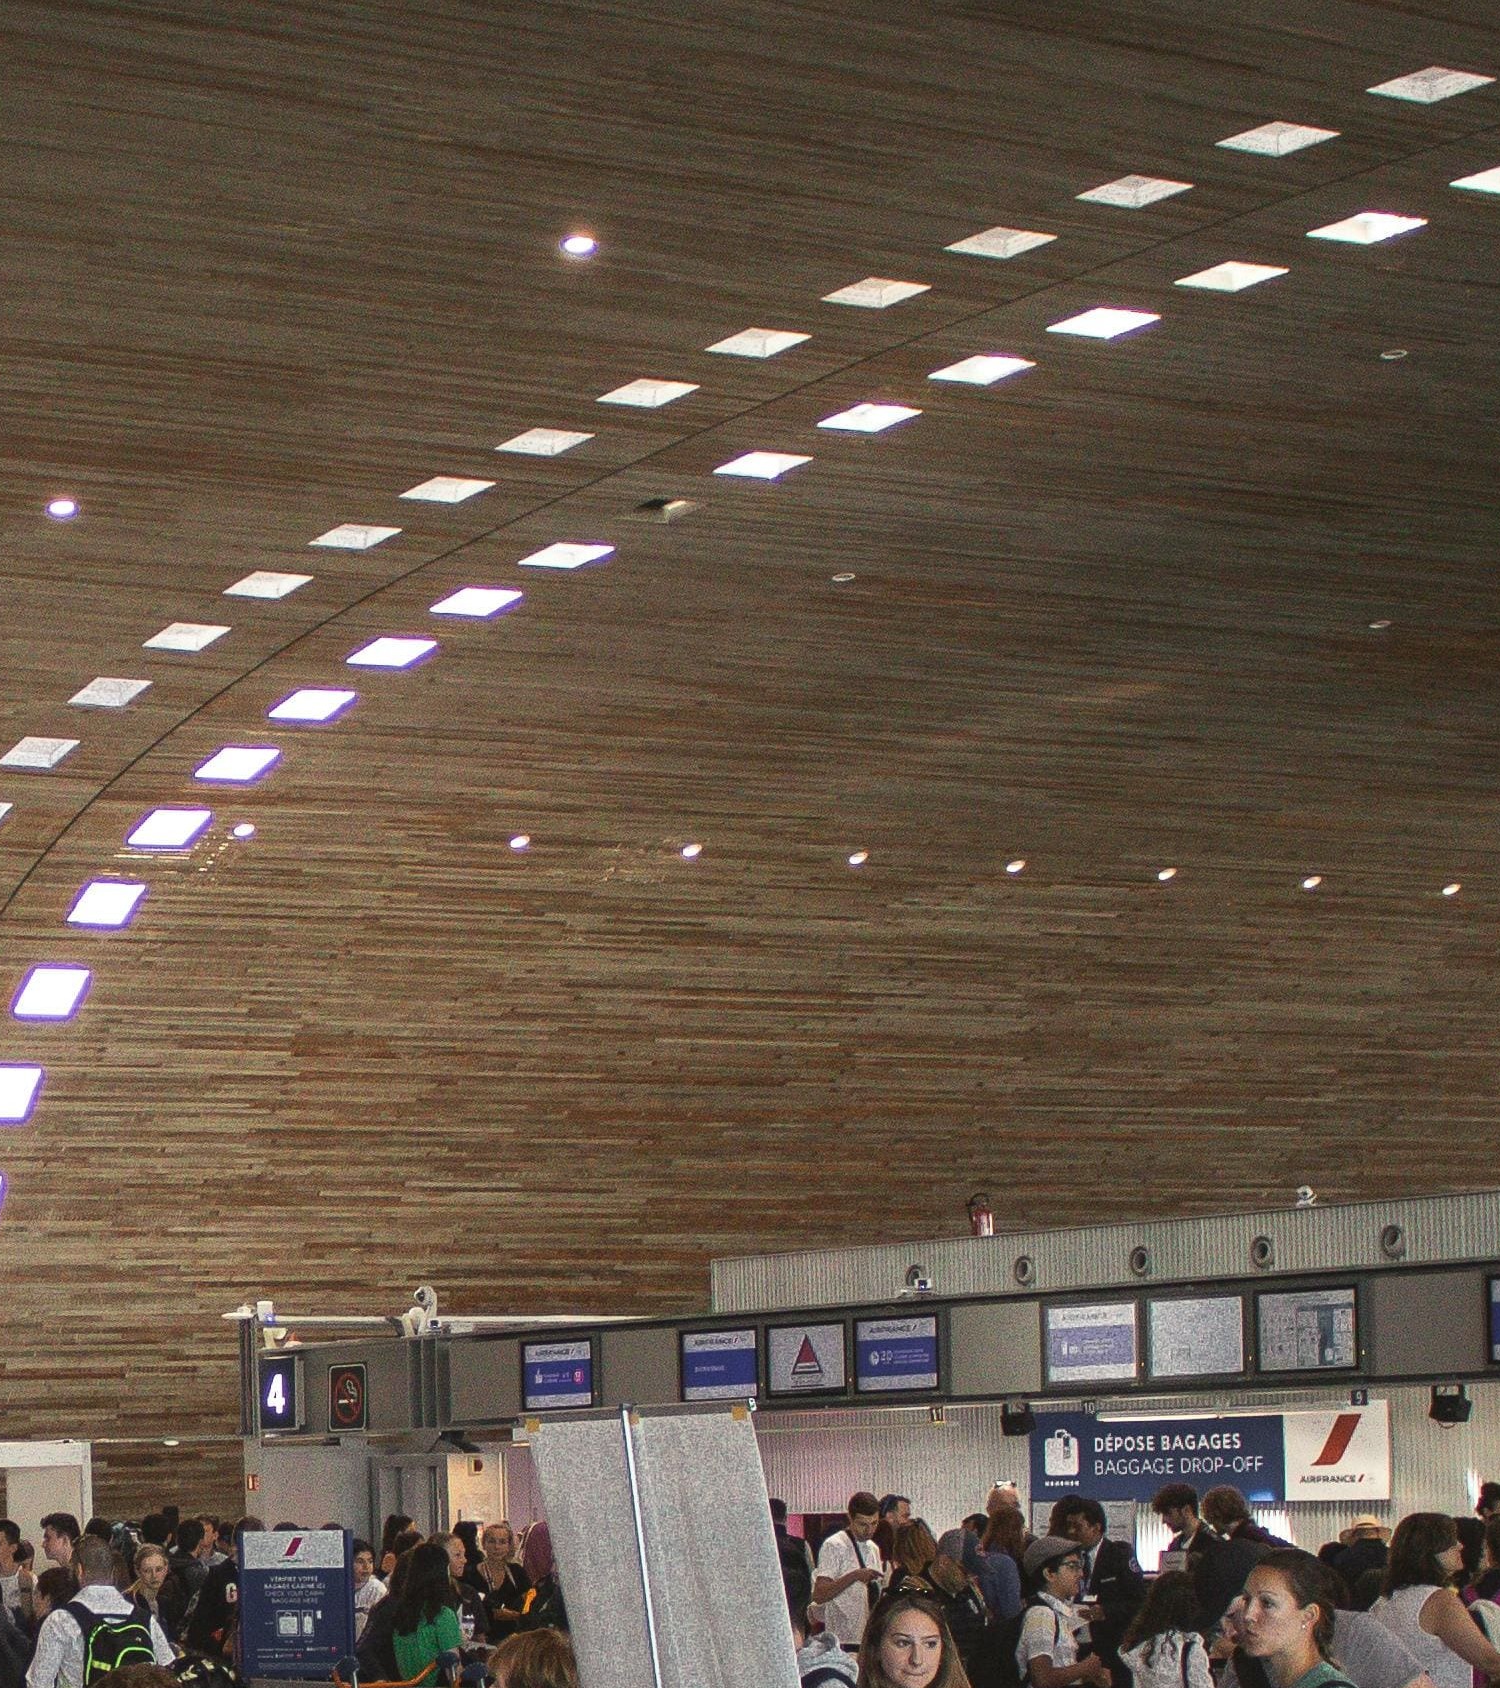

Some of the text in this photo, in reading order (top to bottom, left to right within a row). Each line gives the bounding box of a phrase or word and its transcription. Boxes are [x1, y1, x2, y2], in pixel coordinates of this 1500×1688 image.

[266, 1374, 285, 1414] 4
[1094, 1430, 1242, 1453] DÉPOSE BAGAGES
[1093, 1455, 1264, 1476] BAGGAGE DROP-OFF
[1299, 1474, 1358, 1484] AIRFRANCE
